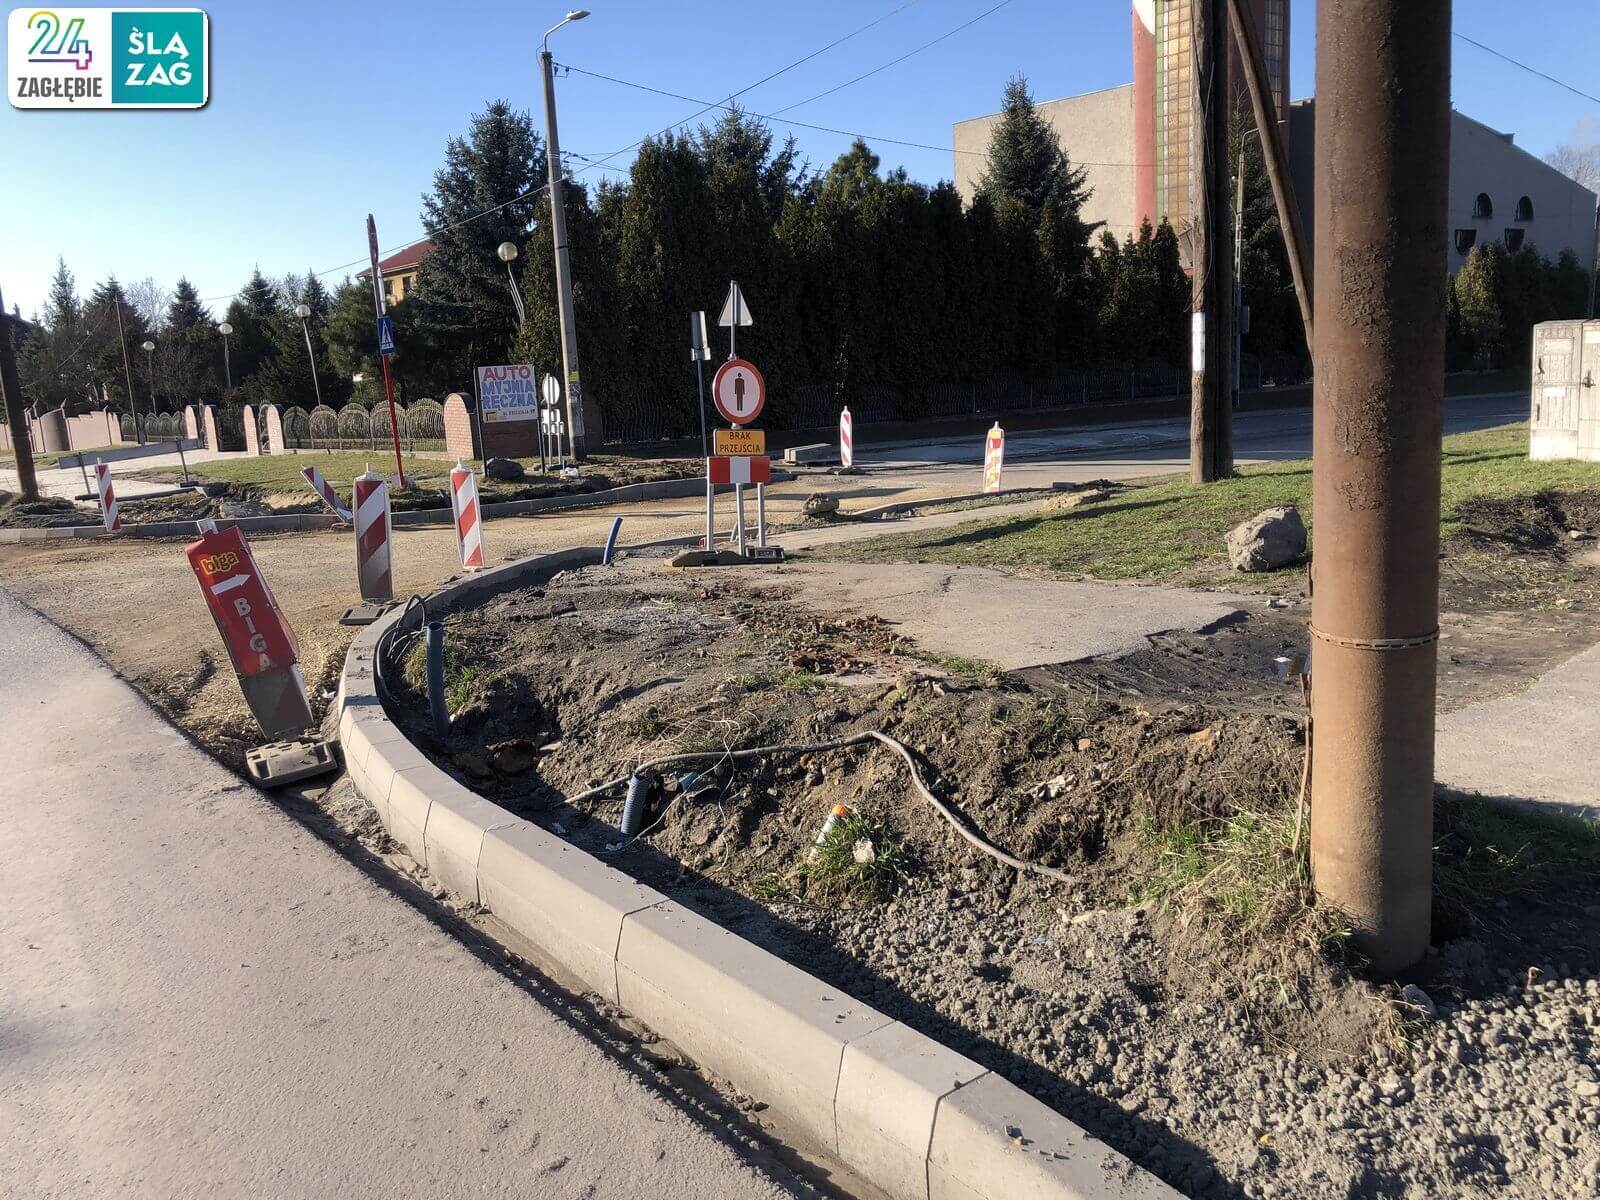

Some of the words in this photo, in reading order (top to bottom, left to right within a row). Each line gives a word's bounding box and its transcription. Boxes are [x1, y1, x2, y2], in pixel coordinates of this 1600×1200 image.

[483, 365, 531, 381] AUTO
[482, 380, 535, 395] MYJNIA
[729, 431, 751, 440] BRAK
[234, 597, 270, 672] BIGA
